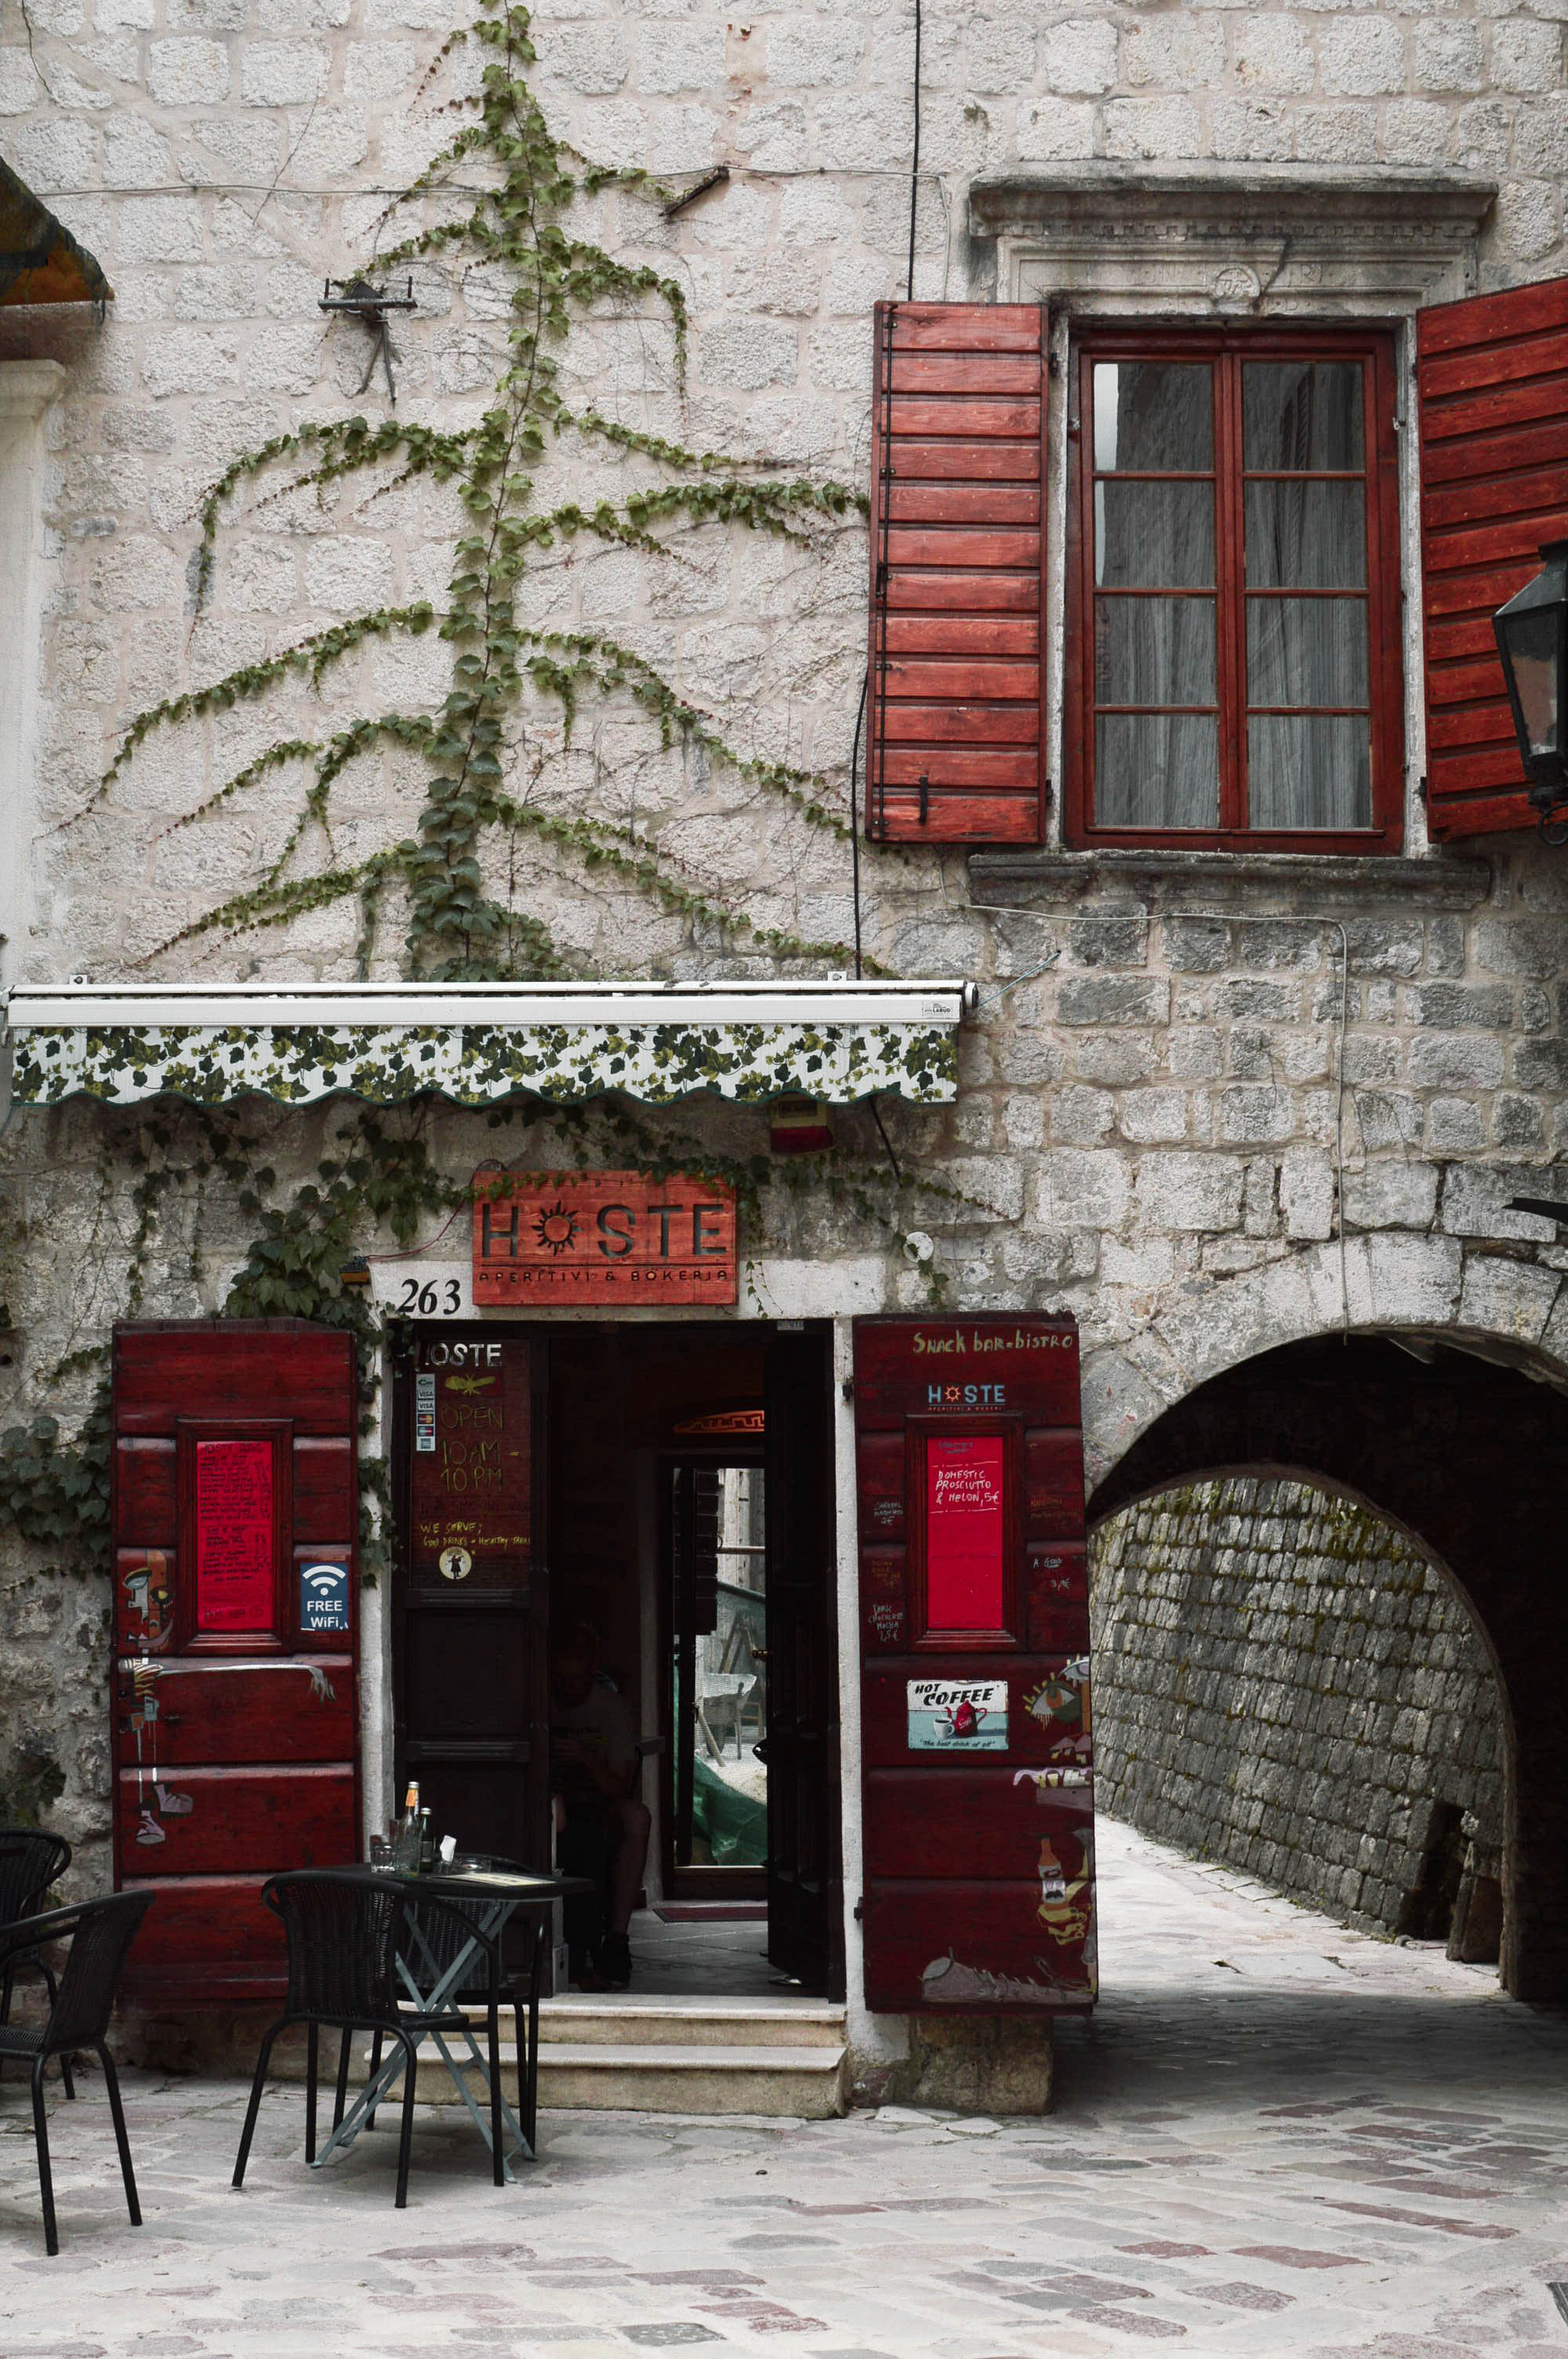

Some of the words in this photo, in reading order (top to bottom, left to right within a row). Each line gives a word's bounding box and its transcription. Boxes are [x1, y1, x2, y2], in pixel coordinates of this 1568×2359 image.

[481, 1201, 728, 1259] HOSTE
[478, 1270, 590, 1282] APERITIVI
[605, 1271, 616, 1281] &
[398, 1278, 462, 1314] 263
[928, 1383, 1007, 1404] HOSTE
[441, 1404, 503, 1430] OPEN
[442, 1439, 468, 1466] 10
[469, 1438, 502, 1465] AM
[440, 1467, 468, 1493] 10
[473, 1466, 503, 1493] PM
[938, 1470, 986, 1481] DOMESTIC
[935, 1479, 992, 1491] PROSCIUTTO
[420, 1523, 440, 1534] WE
[307, 1600, 343, 1612] FREE
[310, 1616, 339, 1628] WiFi
[915, 1684, 942, 1694] HOT
[923, 1688, 994, 1706] COFFEE
